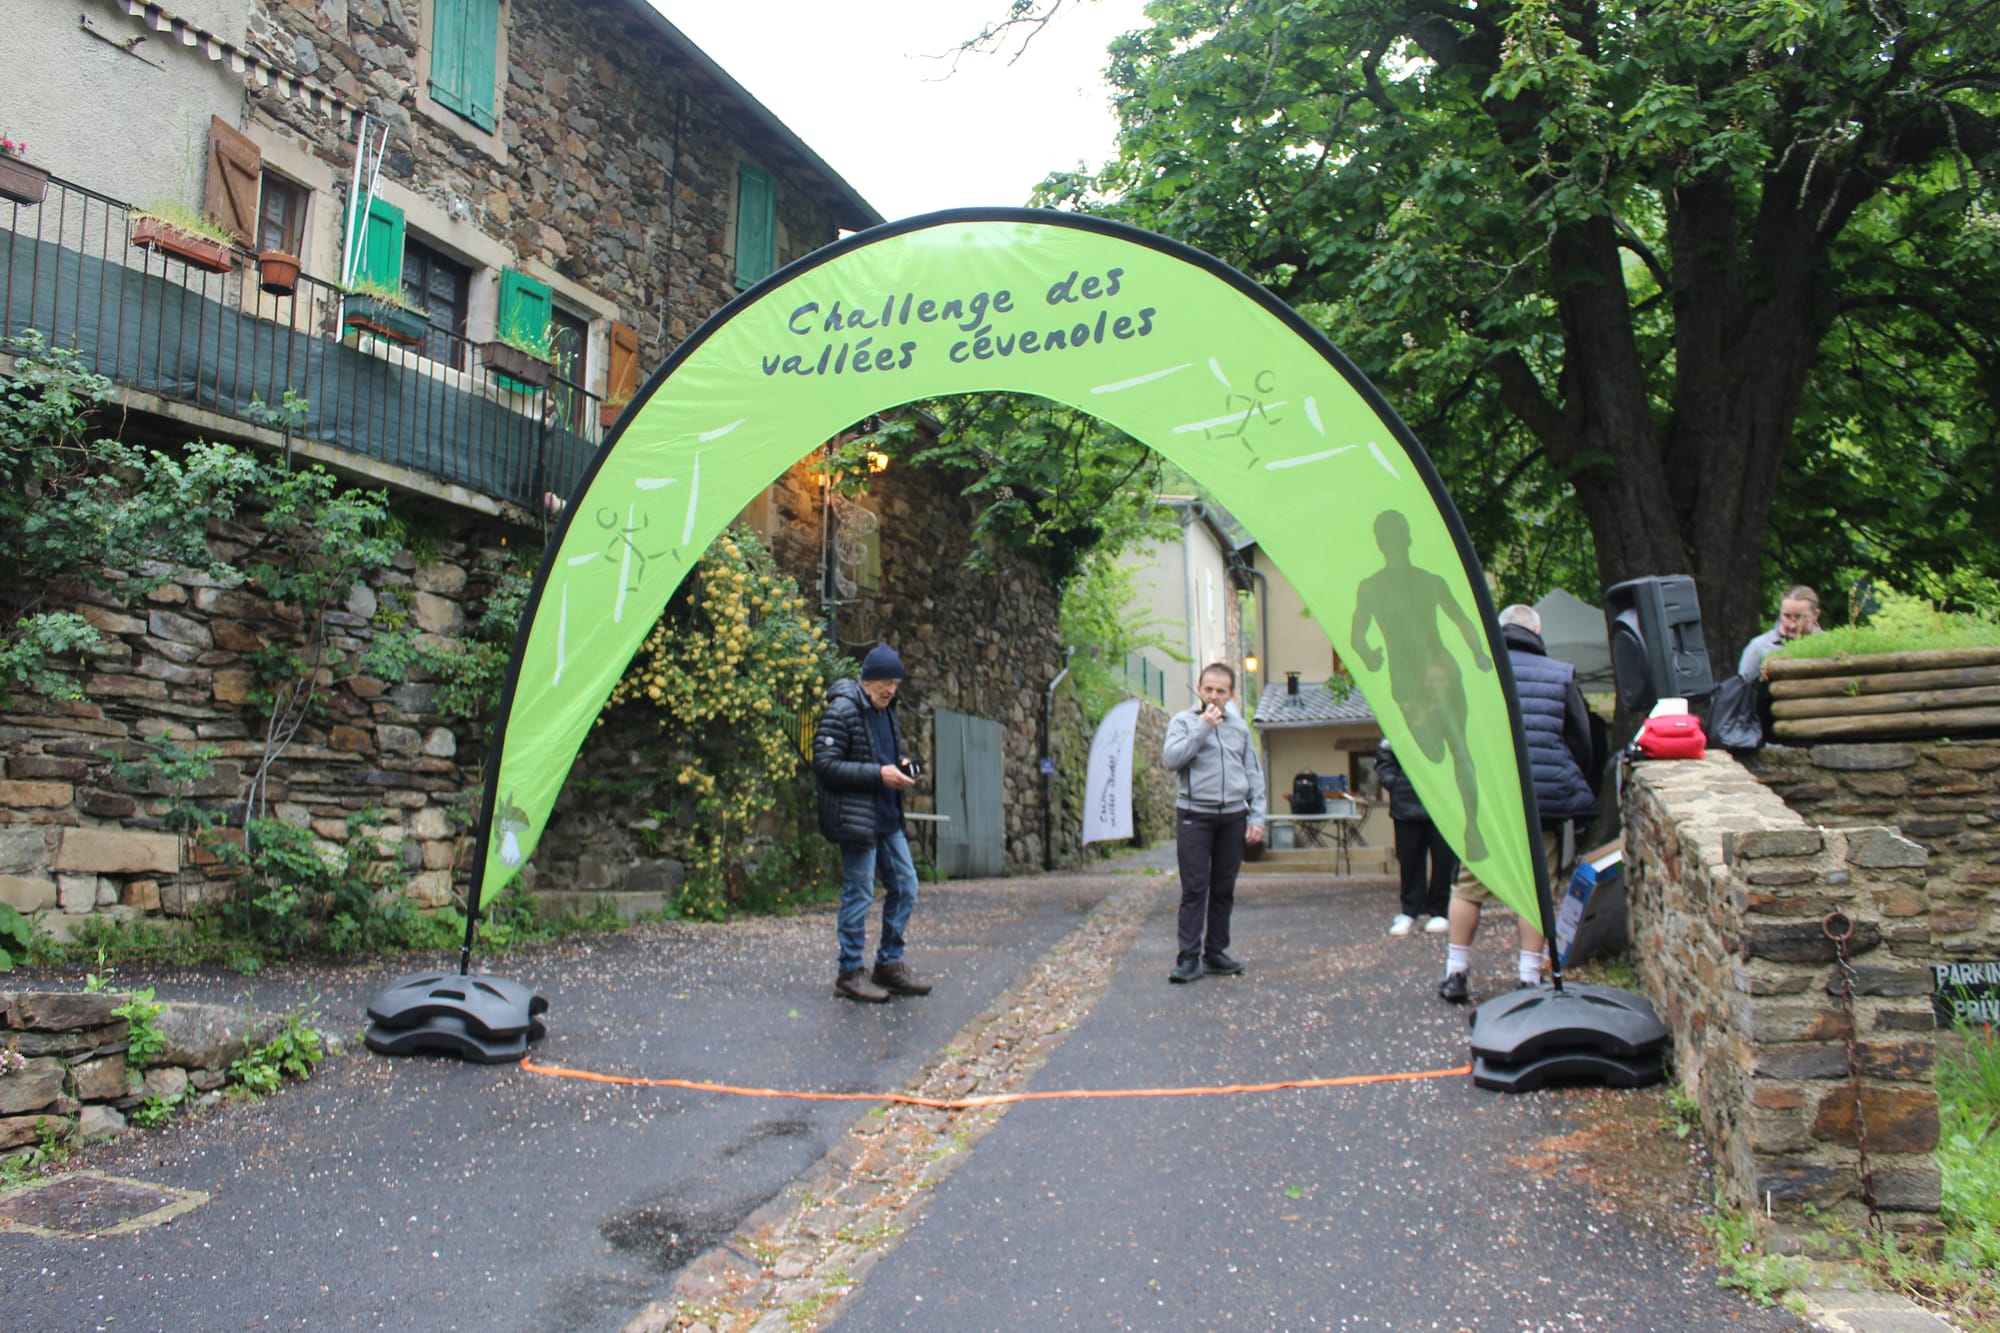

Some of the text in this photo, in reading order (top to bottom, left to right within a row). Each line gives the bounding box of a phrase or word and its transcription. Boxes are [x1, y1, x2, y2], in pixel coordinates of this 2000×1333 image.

[788, 267, 1124, 336] Challenge des
[762, 307, 1156, 376] vallées cévenoles
